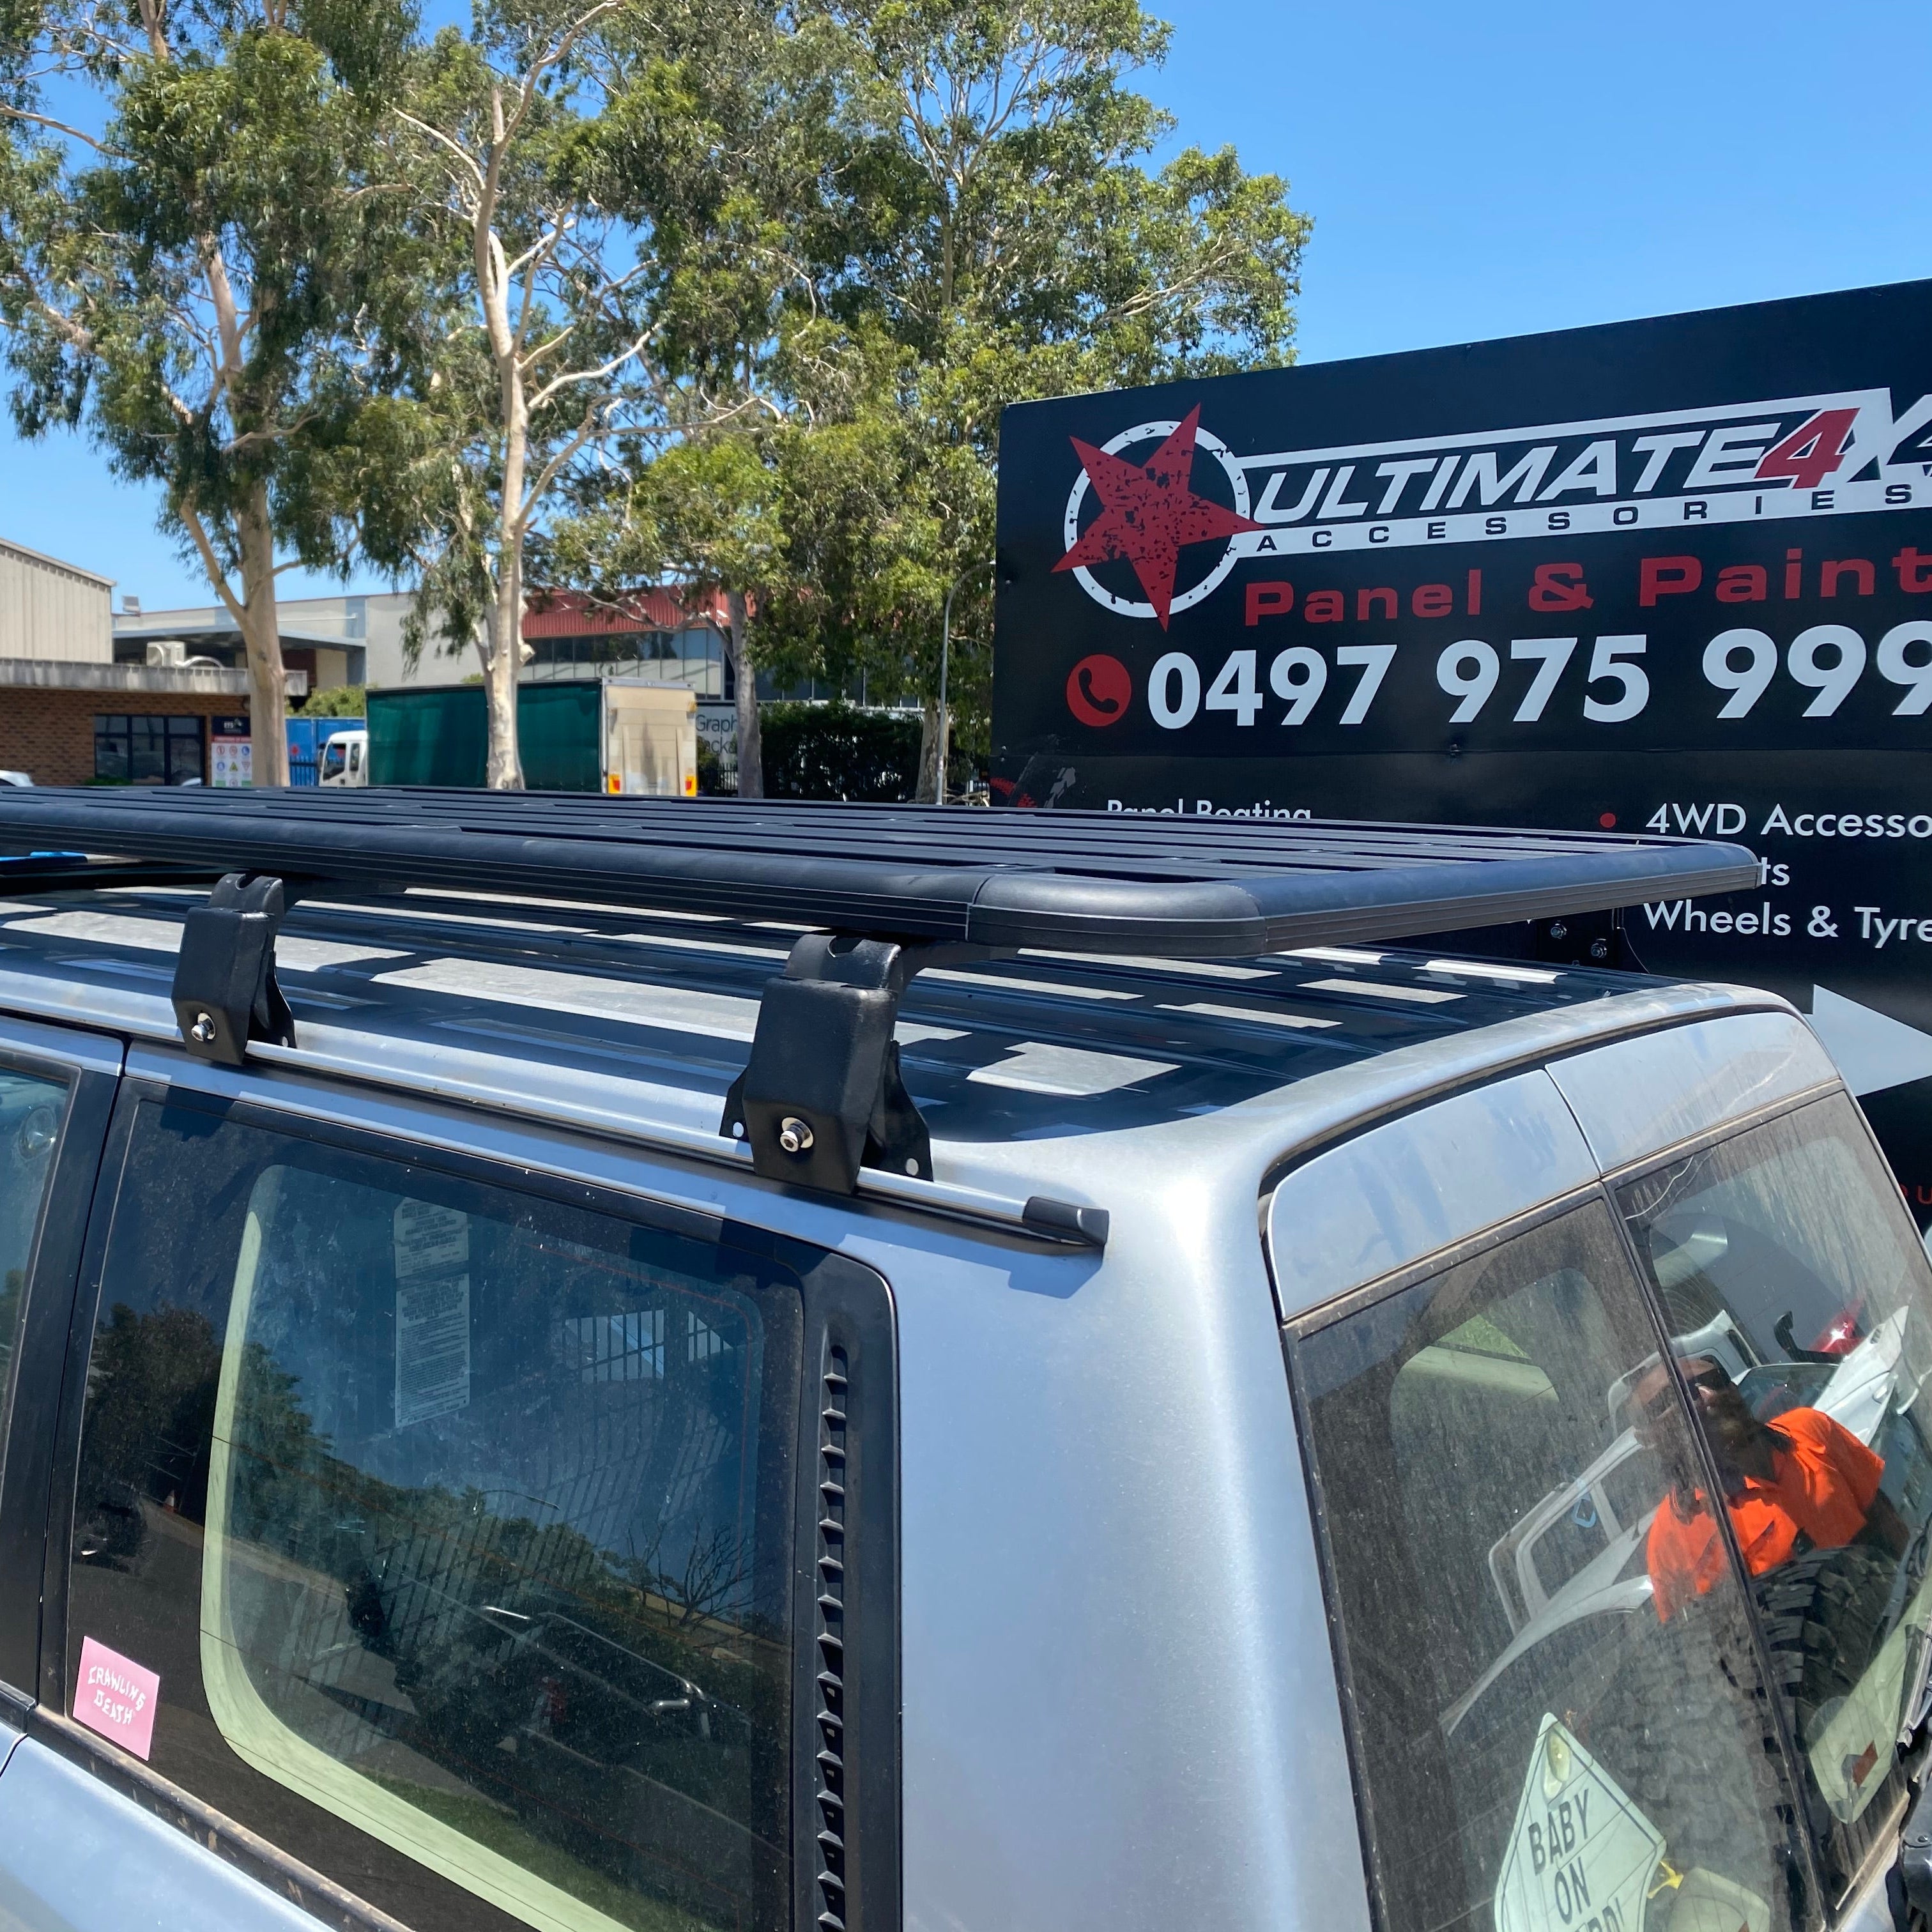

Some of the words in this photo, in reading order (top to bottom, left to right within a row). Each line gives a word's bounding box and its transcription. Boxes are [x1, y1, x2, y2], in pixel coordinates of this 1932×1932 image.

[1256, 484, 1913, 552] ACCESSORIES
[1245, 569, 1482, 626] Panel
[1529, 563, 1594, 612] &
[1639, 547, 1932, 607] Paint
[1148, 645, 1397, 729] 0497
[1436, 634, 1650, 723] 975
[1703, 620, 1932, 719] 999
[1646, 803, 1746, 834] 4WD
[1761, 803, 1932, 838] Accesso
[1644, 899, 1791, 936] Wheels
[1807, 905, 1838, 937] &
[1855, 906, 1932, 948] Tyre
[88, 1666, 146, 1711] CRAWLING
[94, 1690, 133, 1724] DEATH
[1528, 1789, 1589, 1876] BABY
[1554, 1857, 1591, 1925] ON
